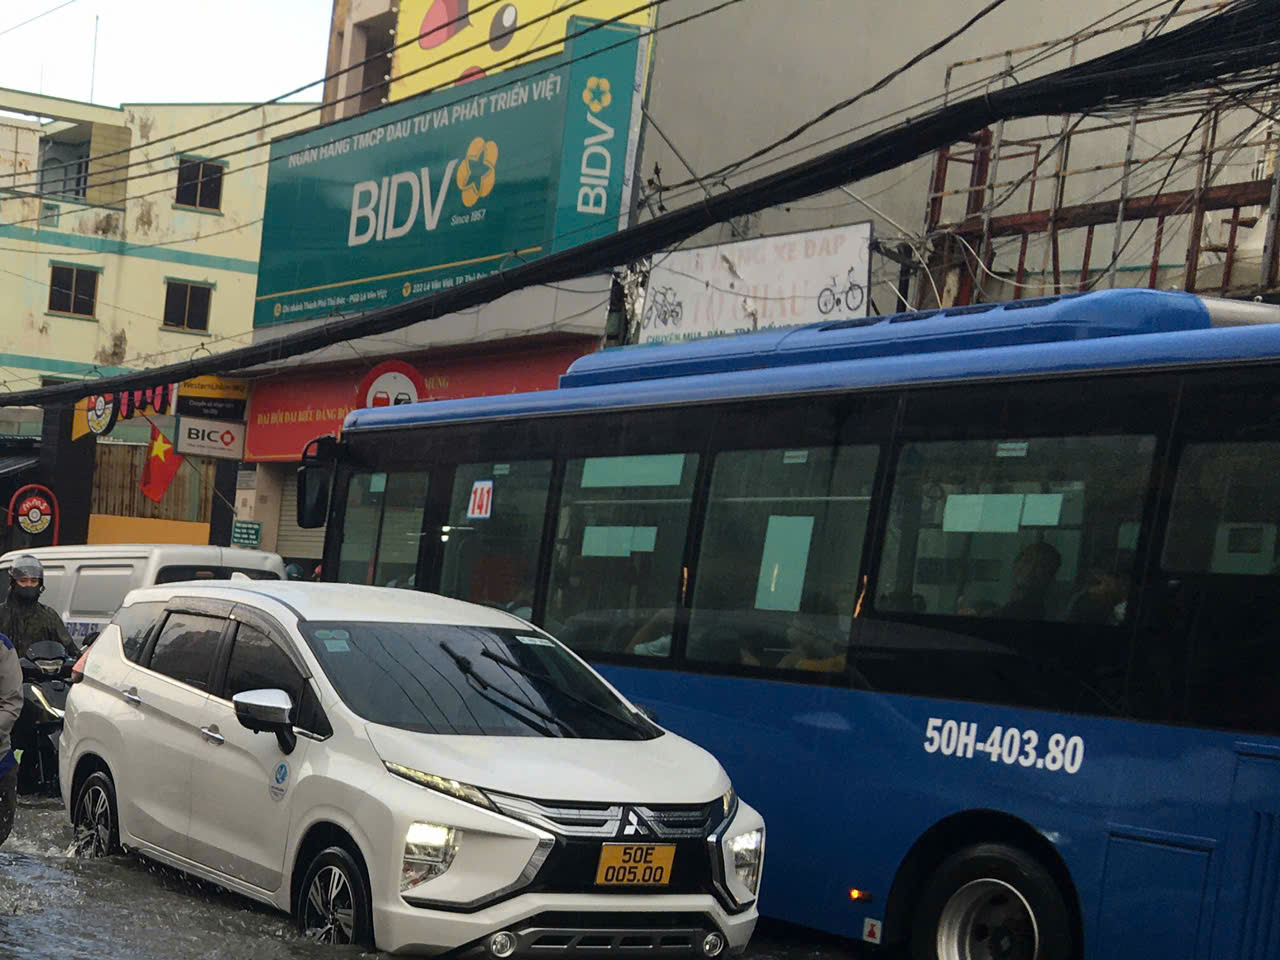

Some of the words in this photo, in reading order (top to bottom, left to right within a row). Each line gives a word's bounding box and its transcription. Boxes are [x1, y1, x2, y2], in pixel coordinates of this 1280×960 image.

[352, 128, 384, 151] TMCP
[577, 111, 615, 216] BIDV
[347, 157, 459, 247] BIDV
[472, 487, 491, 516] 141
[923, 716, 1086, 774] 50H-403.80
[621, 846, 656, 865] 50E
[604, 865, 665, 883] 005.00
